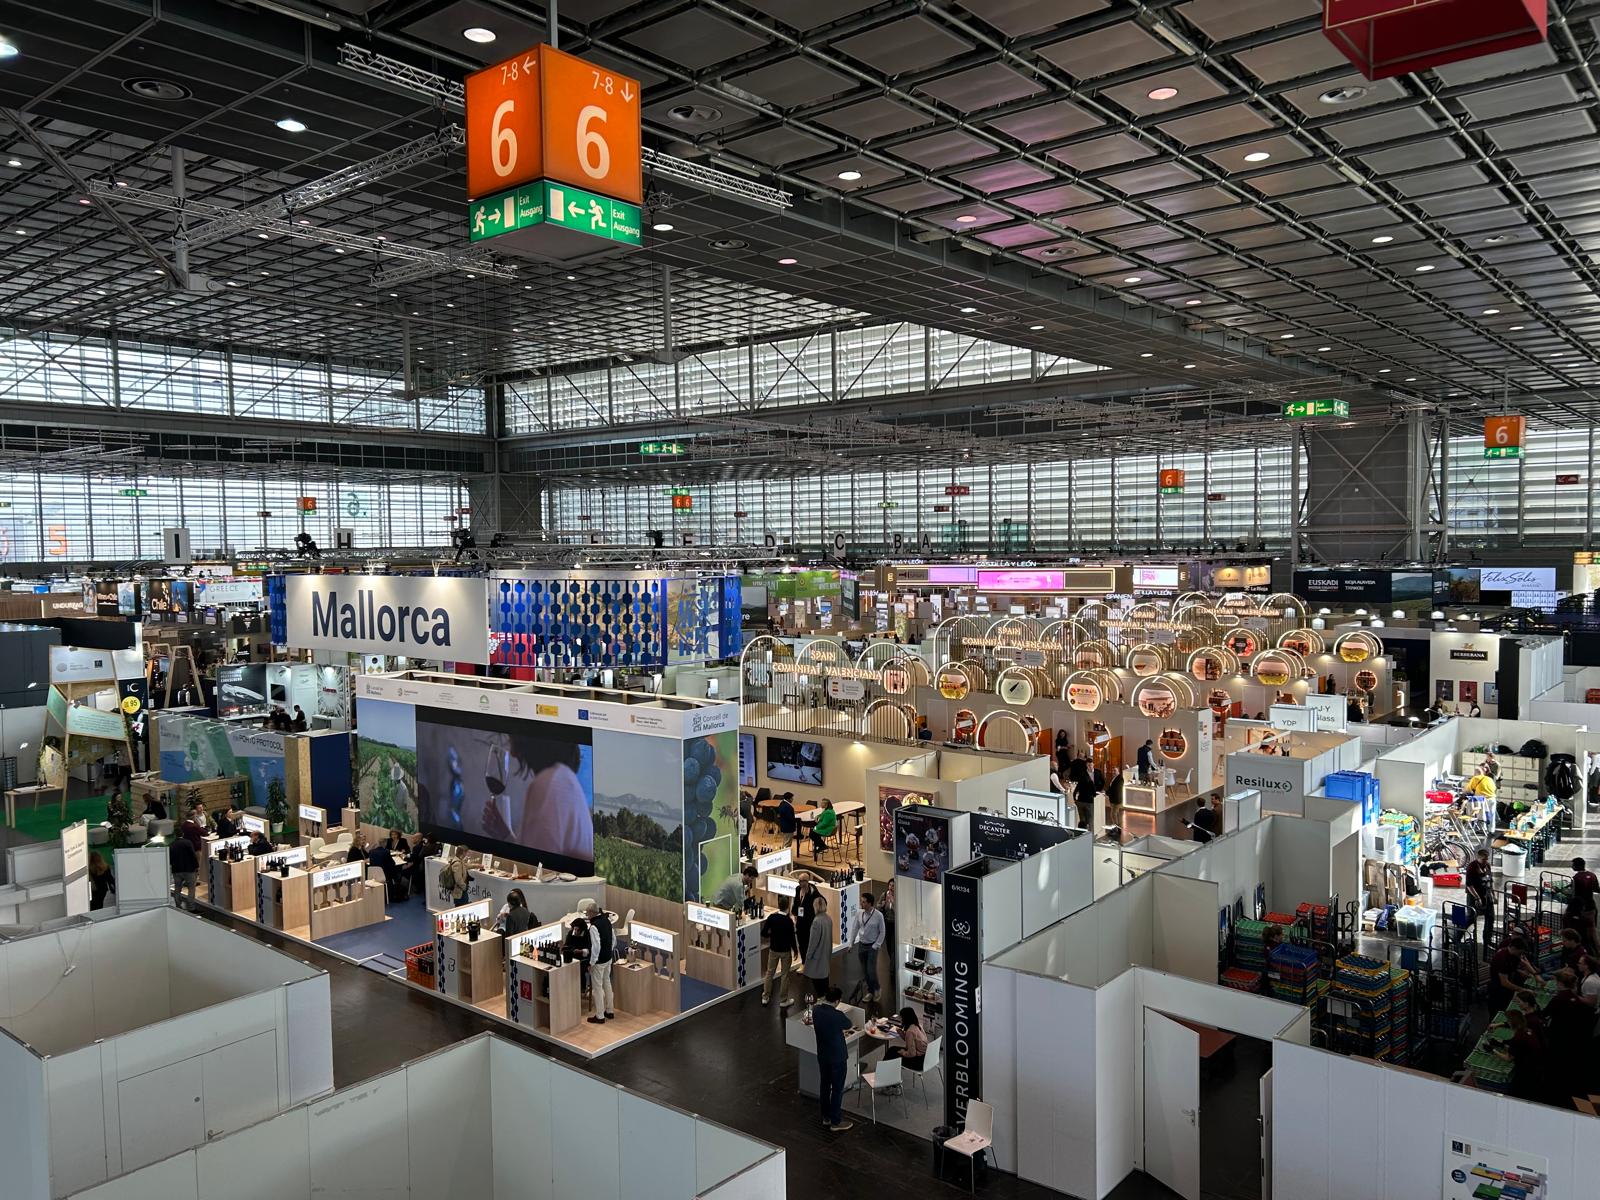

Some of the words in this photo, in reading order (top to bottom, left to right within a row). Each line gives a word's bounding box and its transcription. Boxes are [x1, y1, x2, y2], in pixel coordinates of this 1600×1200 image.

[501, 61, 519, 85] 7-8
[592, 71, 614, 95] 7-8
[491, 99, 518, 177] 6
[576, 105, 610, 180] 6
[519, 195, 530, 206] Exit
[520, 203, 543, 219] Ausgang
[612, 208, 626, 220] Exit
[613, 222, 641, 239] Ausgang
[1495, 426, 1509, 444] 6
[1165, 474, 1173, 486] 6
[307, 500, 314, 509] 6
[834, 533, 845, 550] C
[894, 533, 902, 549] B
[922, 533, 931, 548] A
[151, 598, 168, 611] Chile
[311, 589, 451, 647] Mallorca
[997, 627, 1021, 636] SPAIN
[1011, 639, 1063, 650] VALENCIANA
[810, 650, 836, 662] SPAIN
[772, 662, 821, 675] COMUNITAT
[825, 666, 883, 681] VALENCIANA
[702, 714, 722, 723] Consell
[722, 712, 729, 720] de
[1281, 719, 1297, 727] YDP
[702, 721, 725, 731] Mallorca
[1235, 775, 1282, 790] Resilux
[1010, 805, 1055, 822] SPRING
[978, 824, 1011, 834] DECANTER
[481, 888, 492, 898] de
[954, 961, 969, 1135] VERBLOOMING
